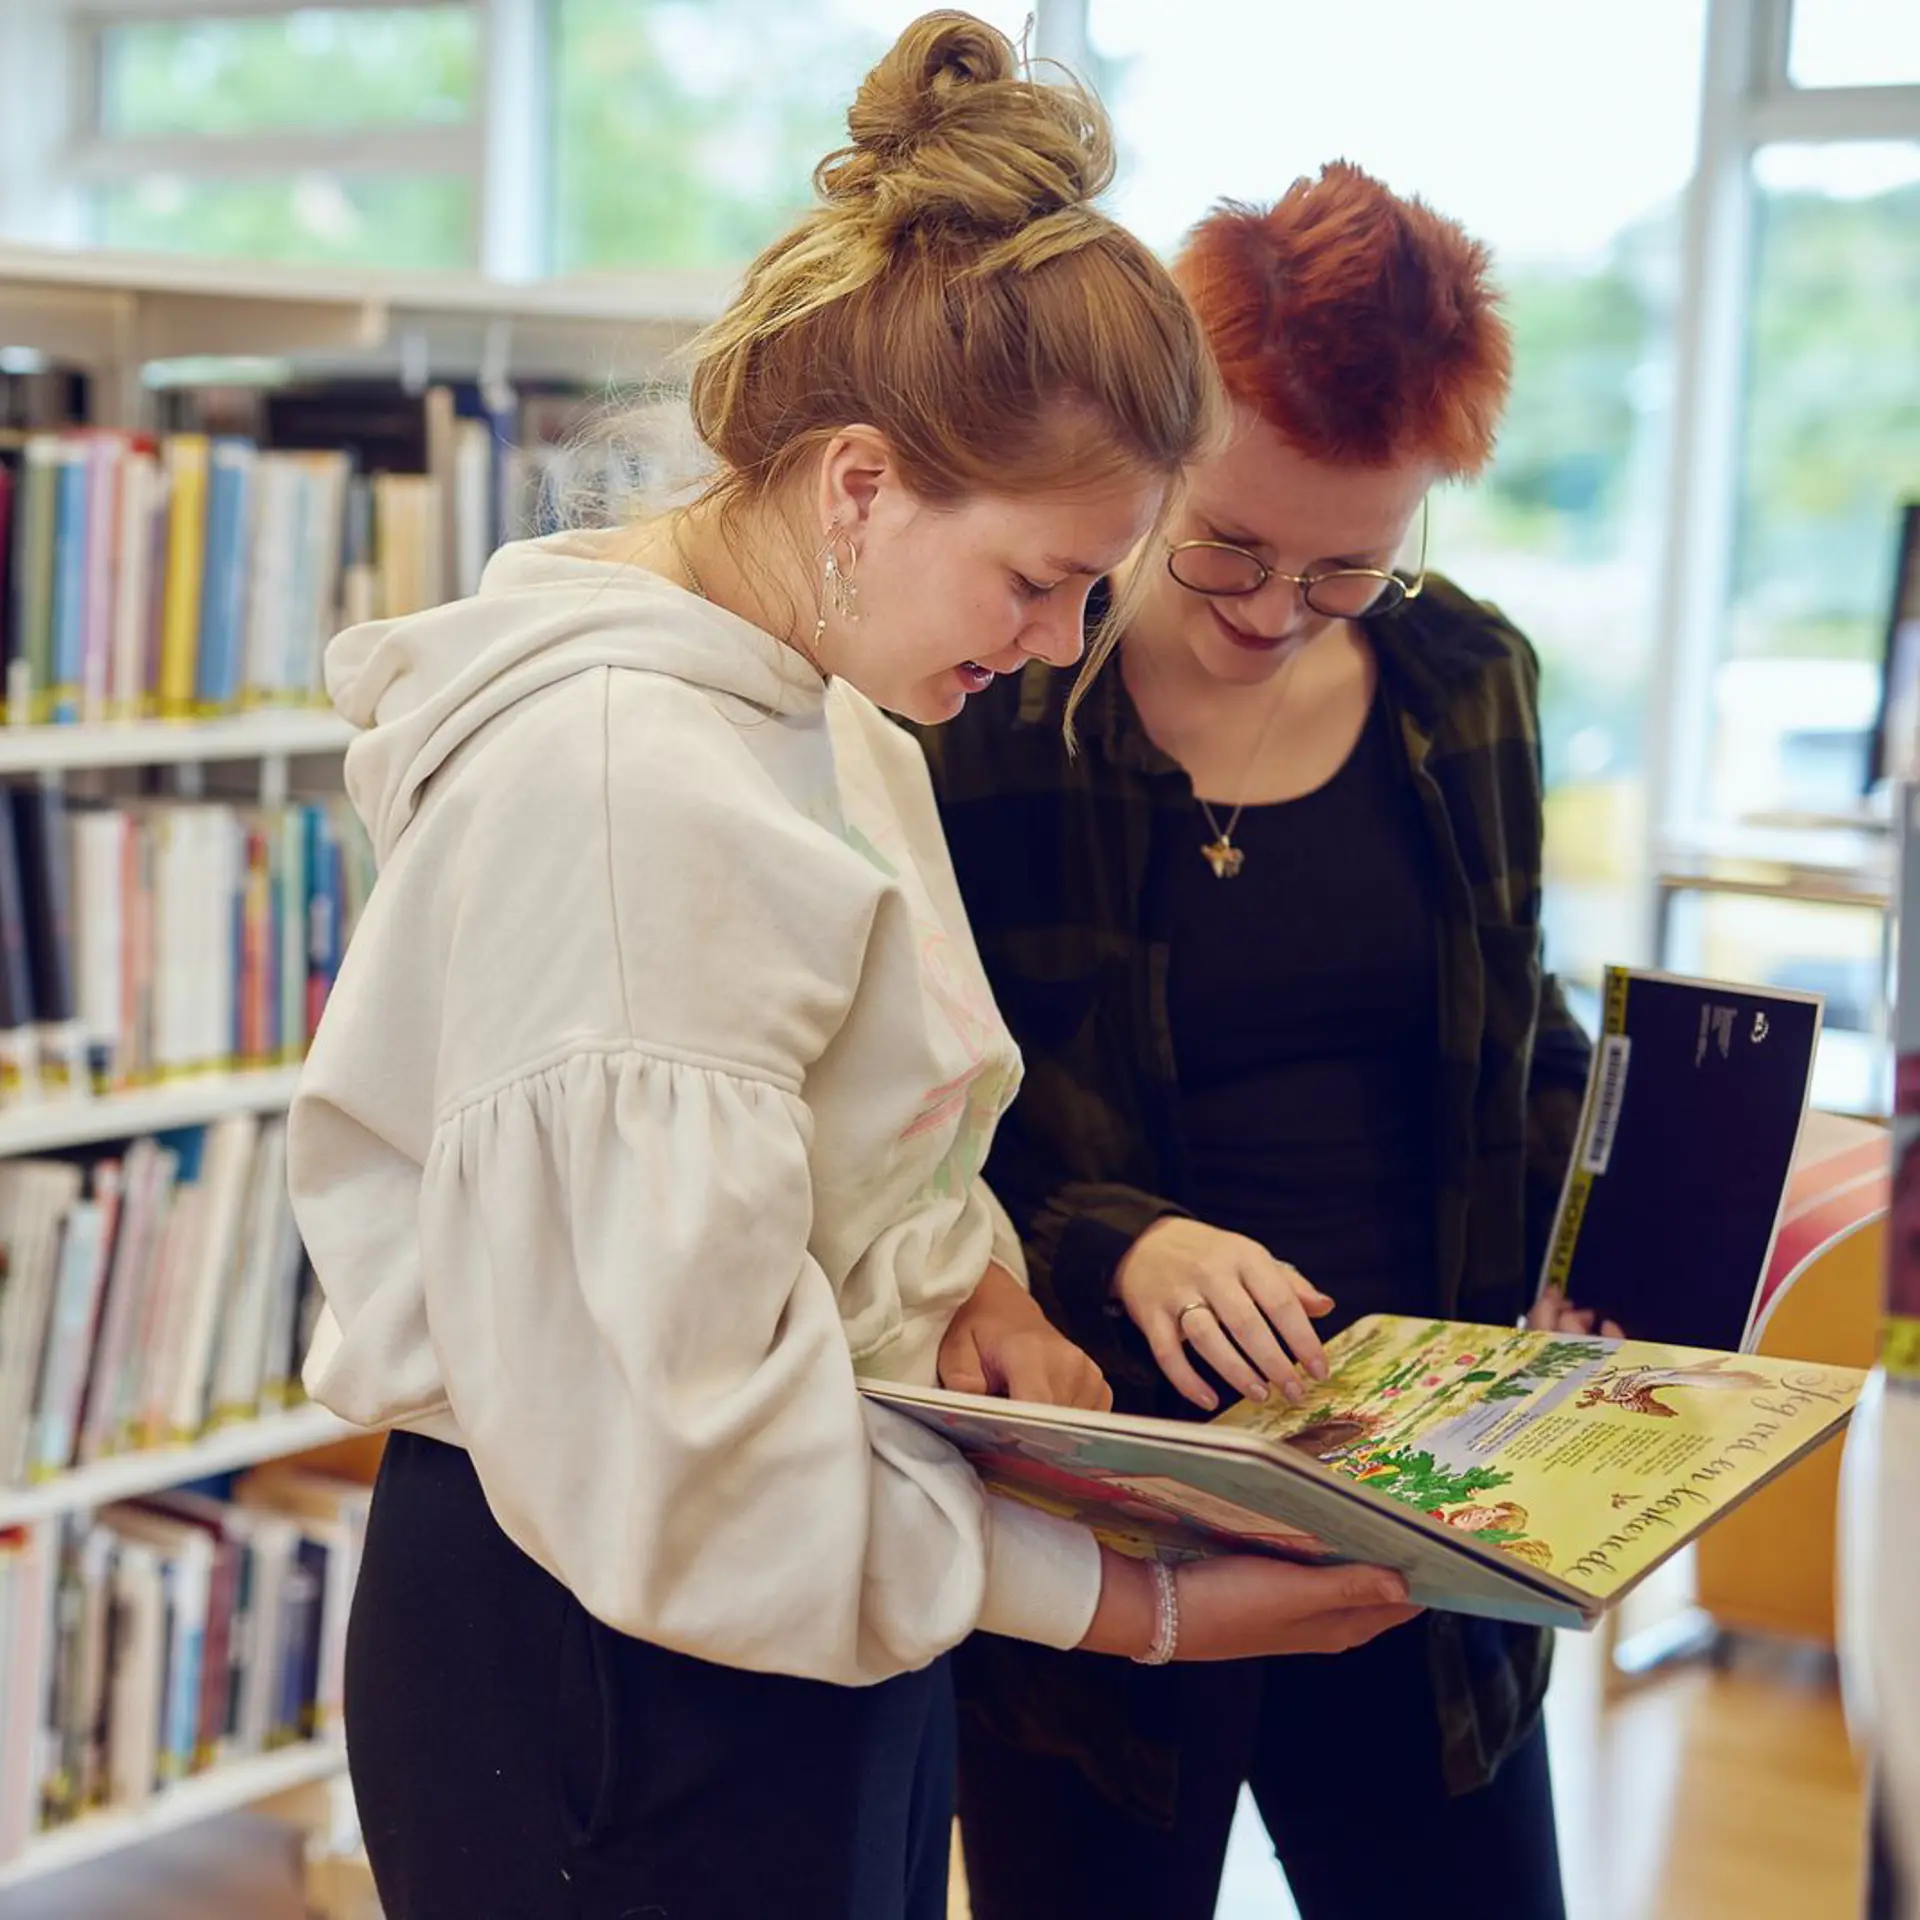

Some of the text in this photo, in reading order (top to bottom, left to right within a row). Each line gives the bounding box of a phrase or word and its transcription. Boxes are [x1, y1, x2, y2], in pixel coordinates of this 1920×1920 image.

[1750, 1370, 1862, 1417] Jeg
[1725, 1421, 1781, 1455] ved
[1691, 1457, 1735, 1482] en
